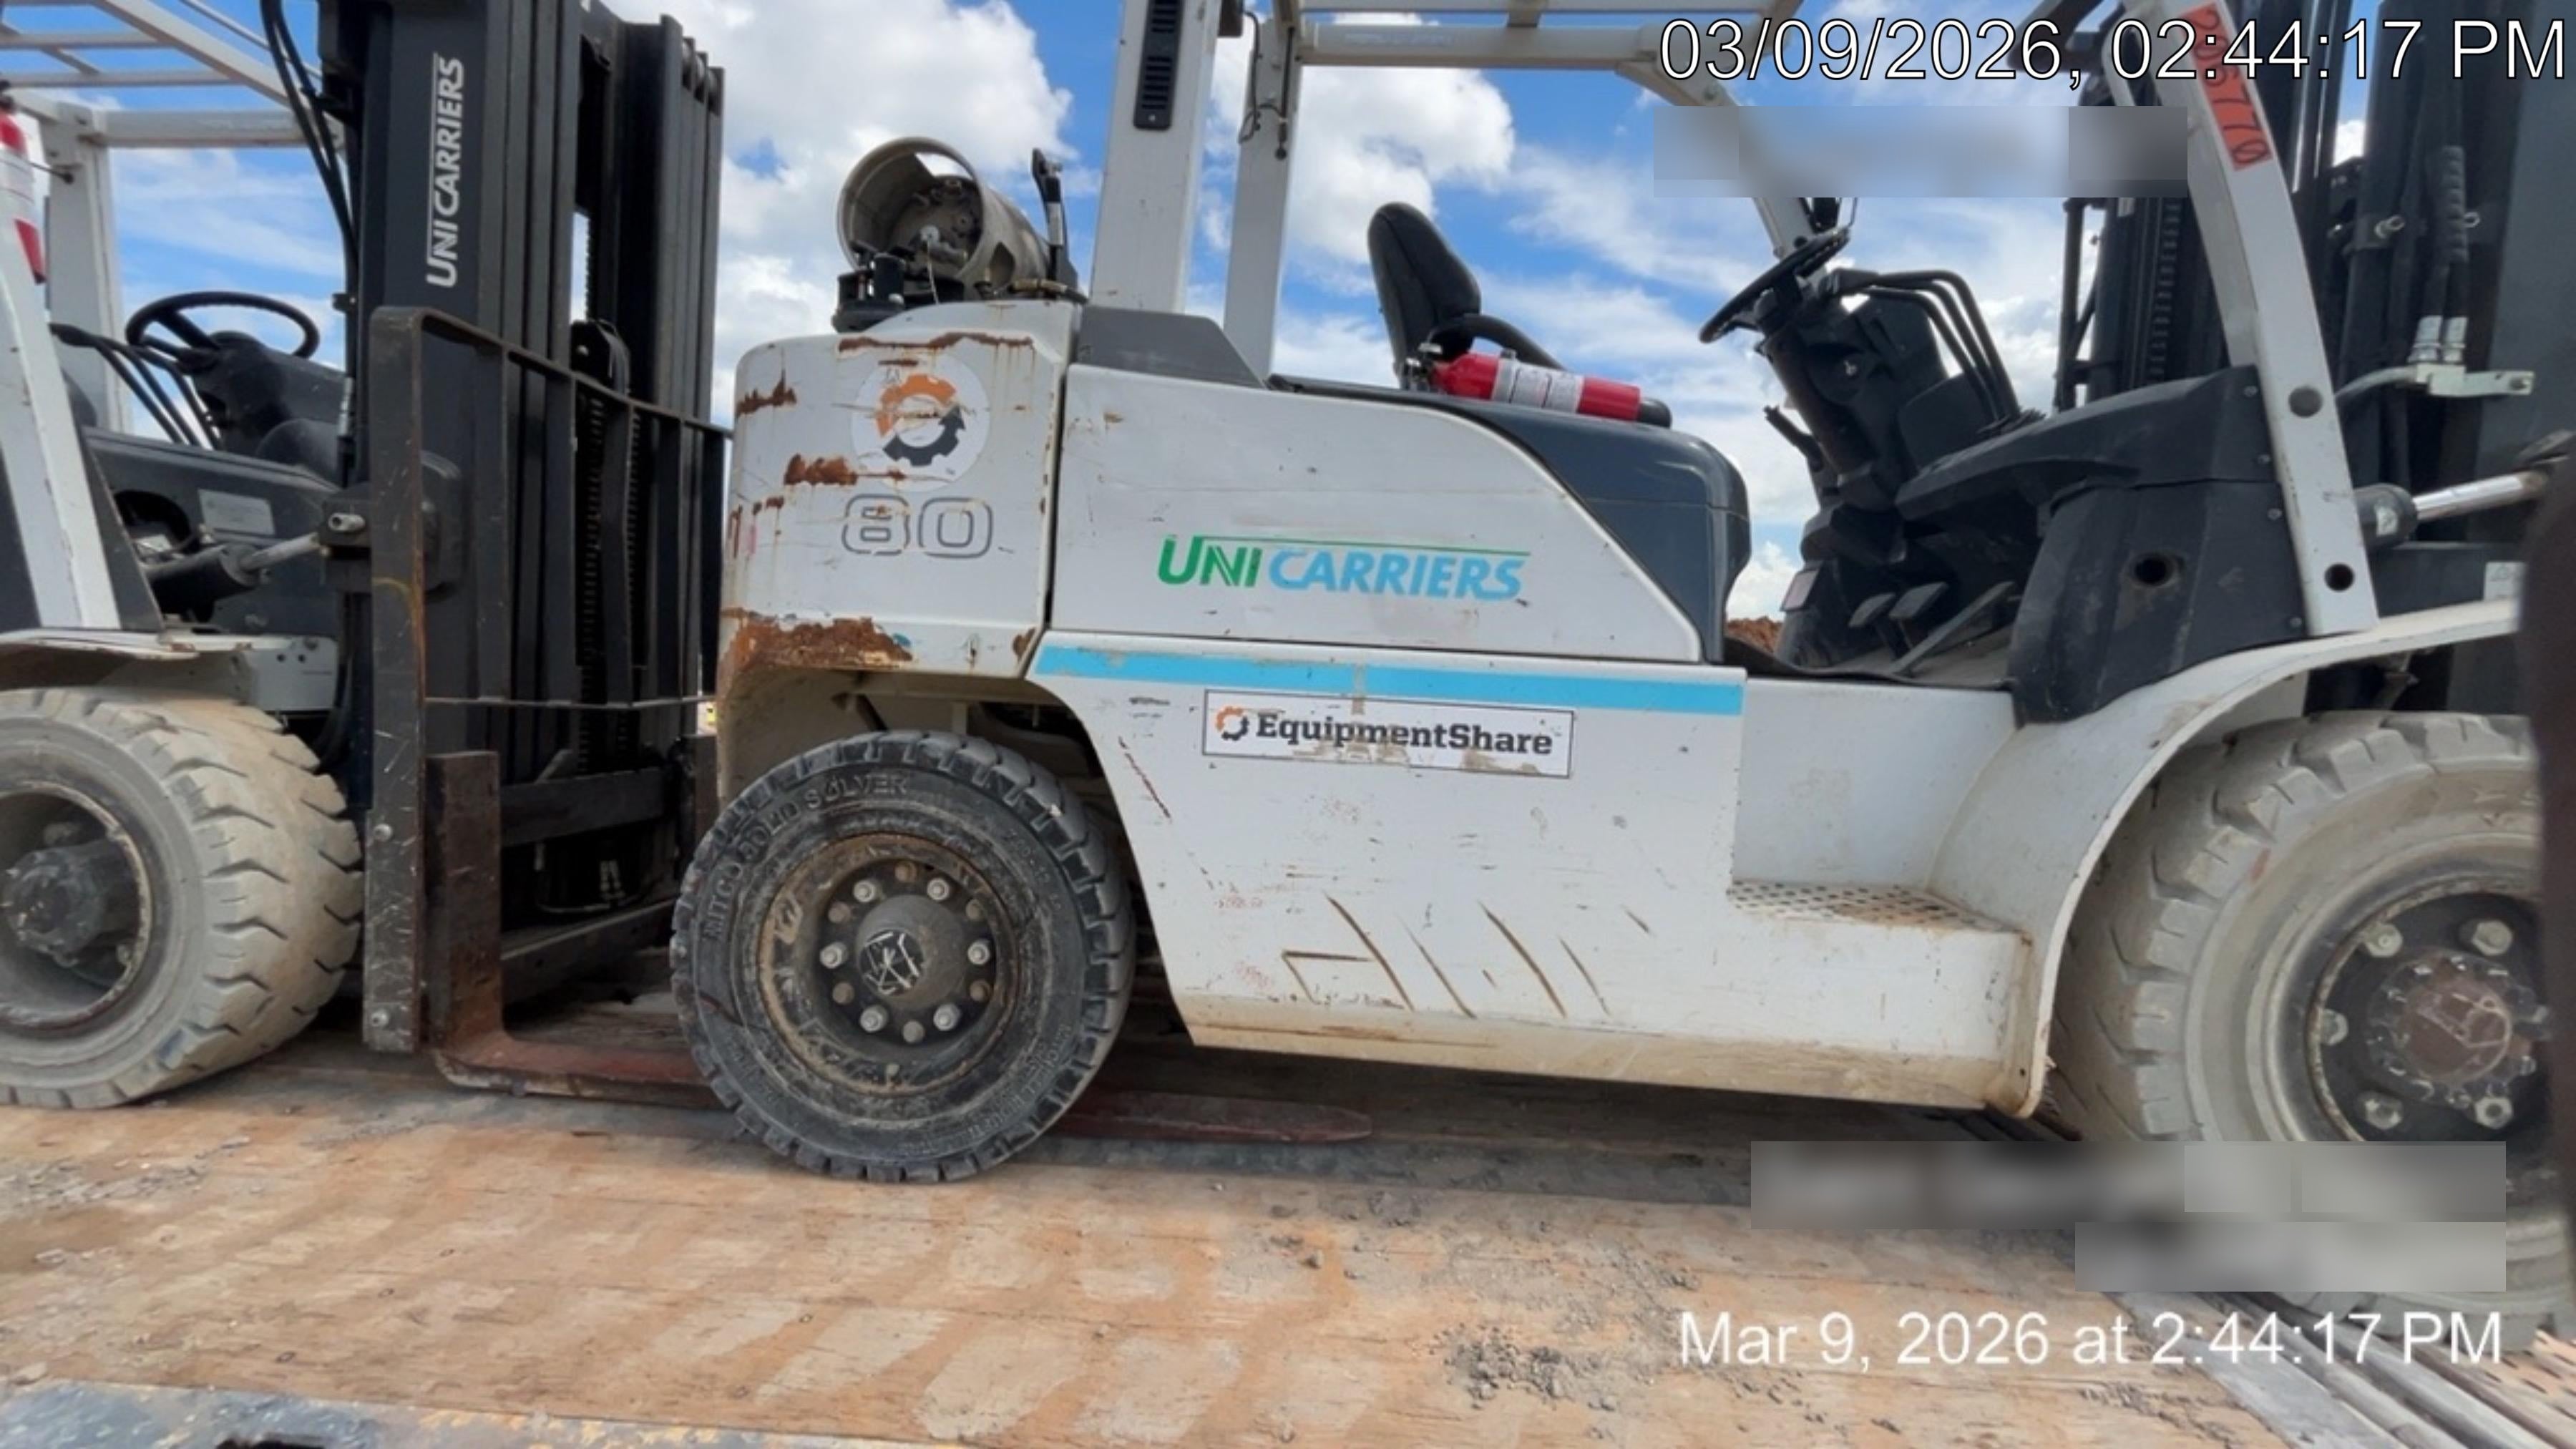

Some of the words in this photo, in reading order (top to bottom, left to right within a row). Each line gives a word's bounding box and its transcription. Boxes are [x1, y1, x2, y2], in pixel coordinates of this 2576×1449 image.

[841, 493, 993, 559] 80
[1257, 714, 1553, 756] EquipmentShare
[804, 773, 910, 809] SOLVER
